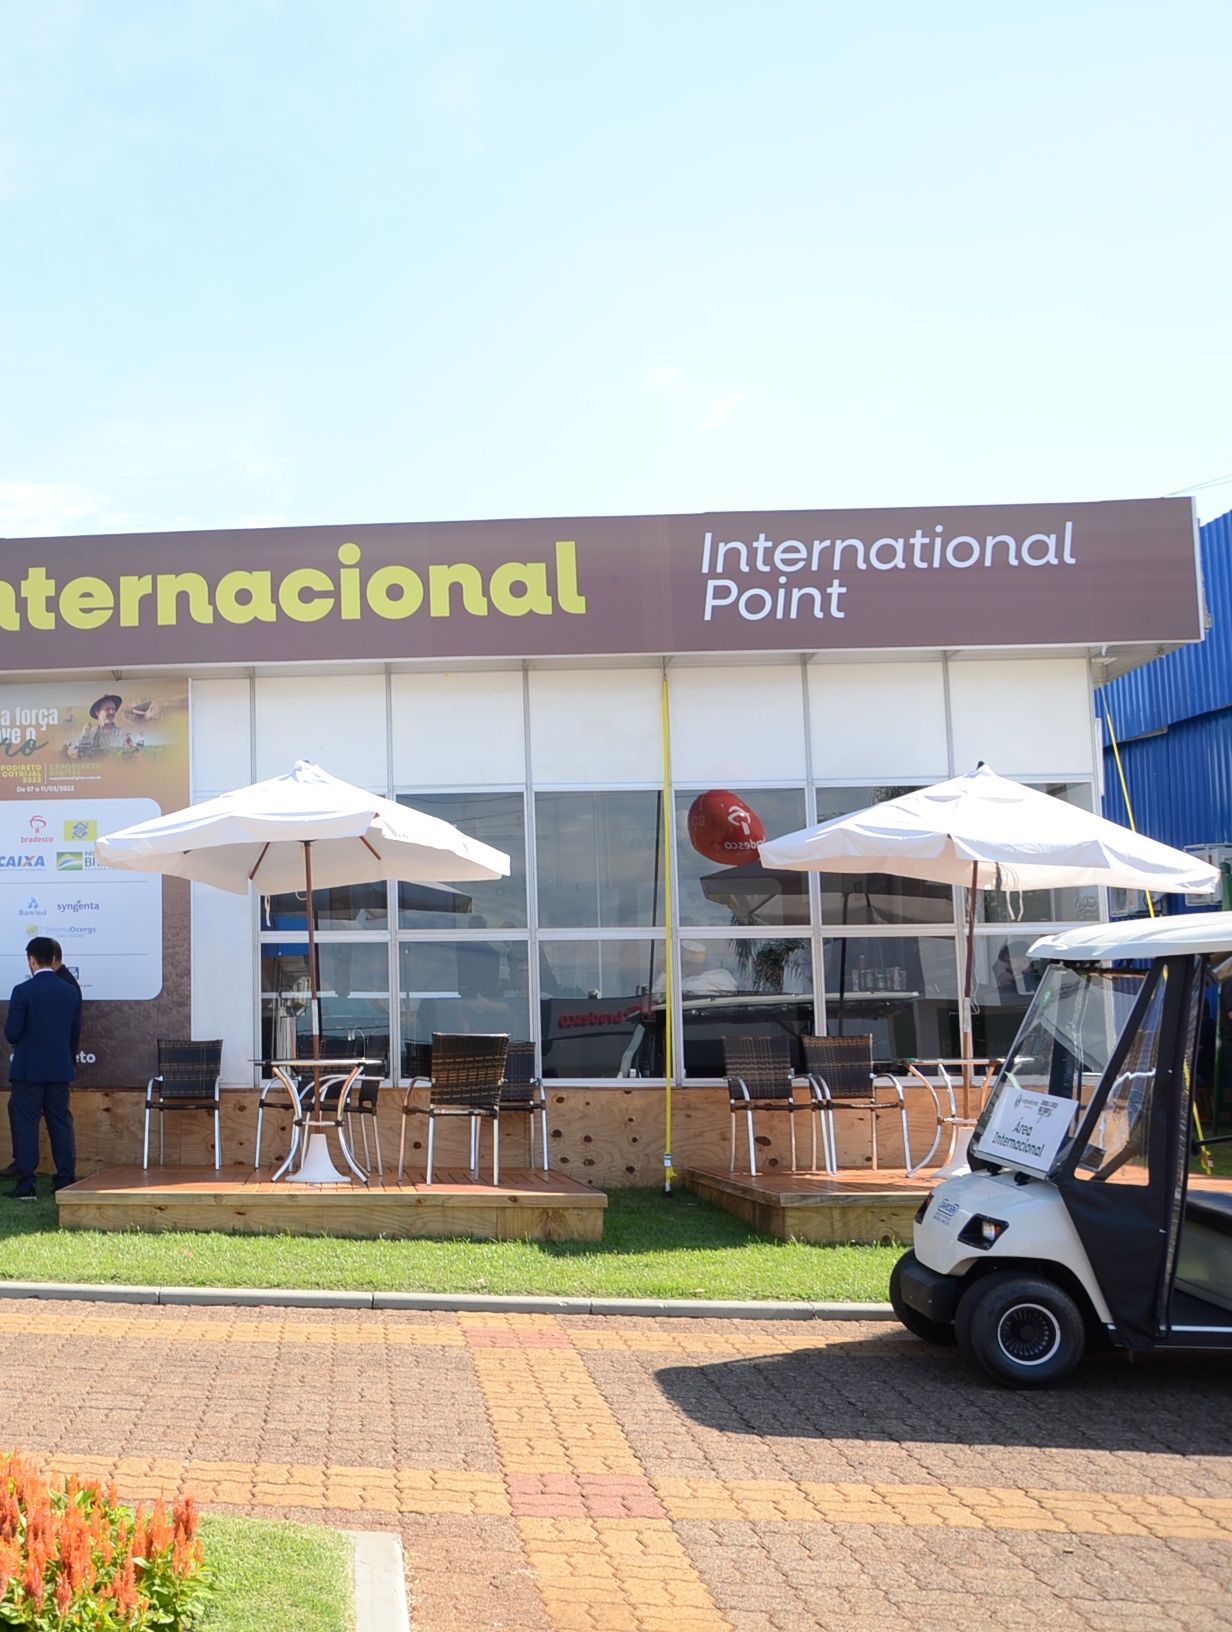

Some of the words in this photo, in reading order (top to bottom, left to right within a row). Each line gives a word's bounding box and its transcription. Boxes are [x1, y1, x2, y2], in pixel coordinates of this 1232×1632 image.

[700, 521, 1077, 574] International
[703, 575, 848, 621] Point
[0, 710, 11, 726] a
[15, 707, 59, 731] força
[26, 727, 37, 744] o
[49, 762, 102, 770] EXPODIRETO
[1, 770, 42, 778] COTRIJAL
[49, 769, 82, 777] DIGITAL
[22, 776, 42, 784] 2022
[26, 785, 34, 793] 07
[40, 785, 75, 793] 11/03/2022
[20, 836, 54, 844] bradesco
[56, 902, 100, 913] syngenta
[18, 909, 47, 917] Banrisul
[1012, 1116, 1033, 1137] Área
[991, 1132, 1046, 1158] Internacional
